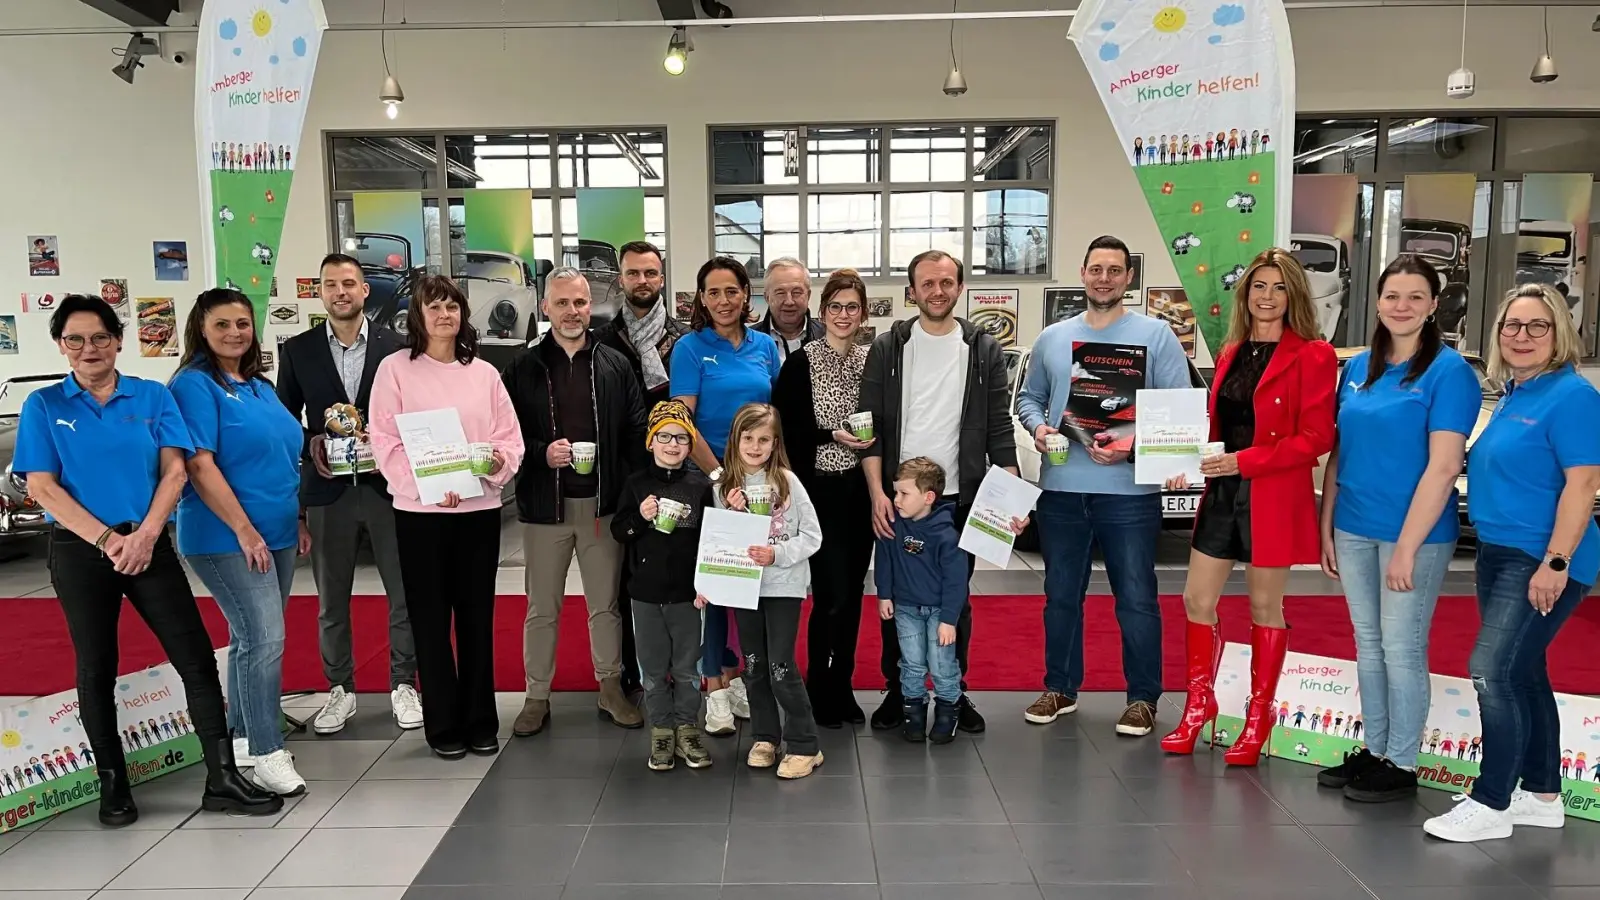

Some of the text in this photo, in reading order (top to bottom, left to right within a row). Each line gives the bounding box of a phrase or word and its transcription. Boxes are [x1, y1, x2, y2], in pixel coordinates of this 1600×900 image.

[1110, 63, 1180, 94] Amberger
[1137, 72, 1259, 103] Kinder helfen!
[228, 88, 261, 108] Kinder
[1083, 355, 1134, 366] GUTSCHEIN
[1162, 497, 1196, 511] ERI
[1300, 678, 1352, 695] Kinder
[122, 686, 172, 710] helfen!
[48, 700, 80, 725] Ambe
